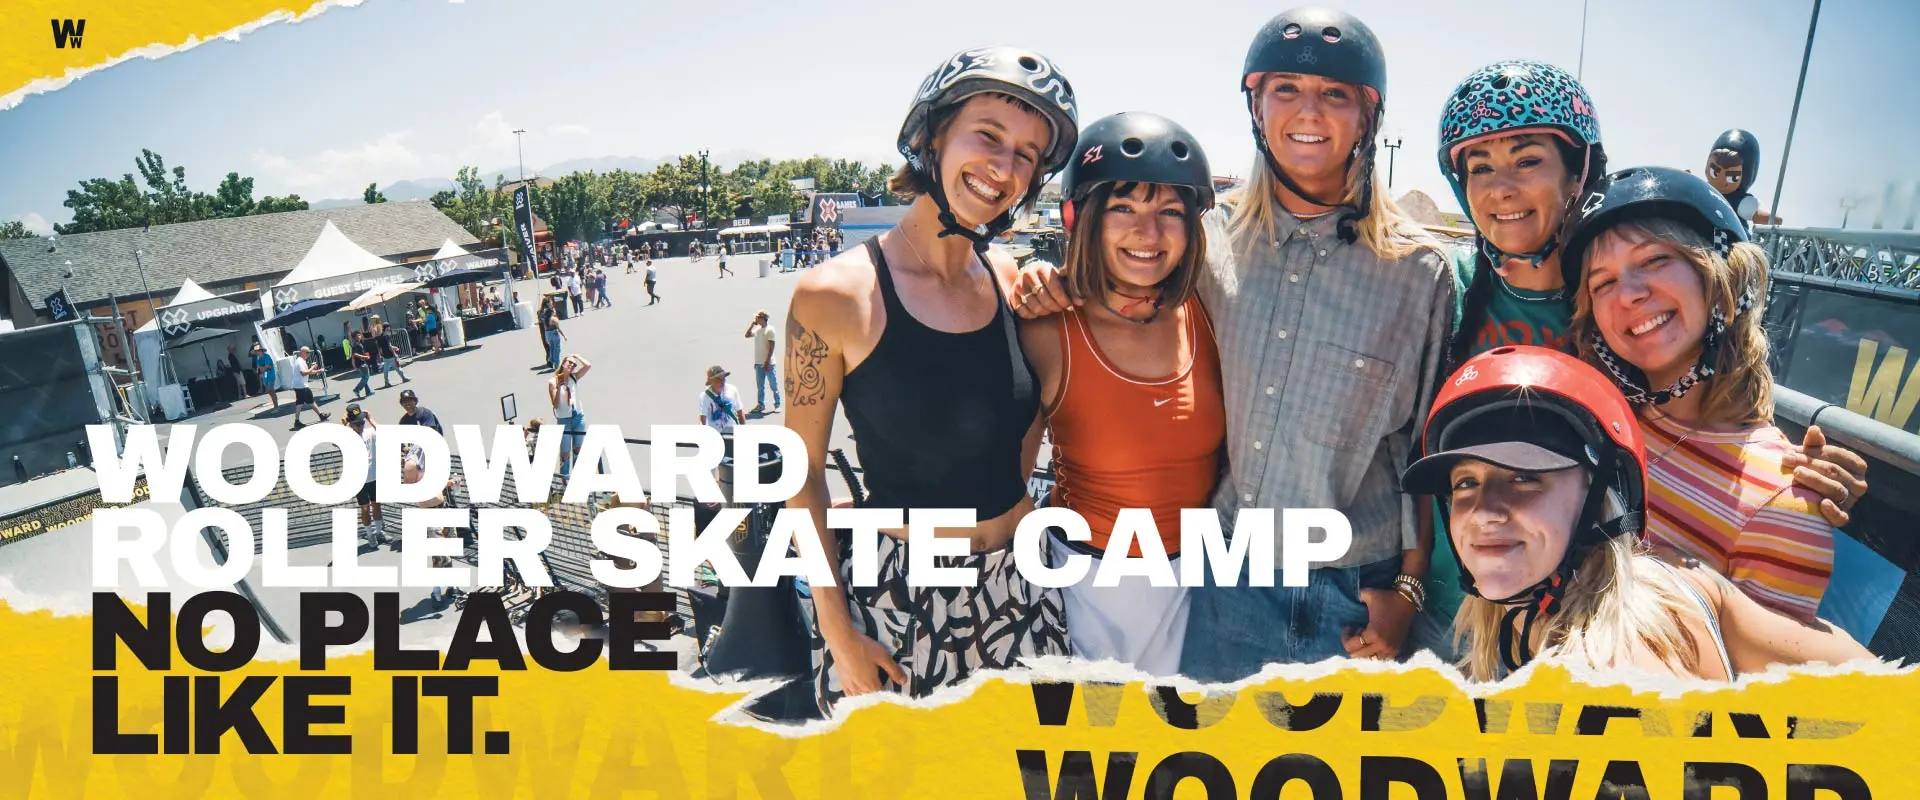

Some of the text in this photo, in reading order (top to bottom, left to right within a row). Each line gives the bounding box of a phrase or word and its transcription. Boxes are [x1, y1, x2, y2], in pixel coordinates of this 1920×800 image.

[732, 218, 751, 227] BEER
[465, 257, 500, 271] WAIVER
[314, 283, 352, 299] GUEST
[352, 273, 406, 292] SERVICES
[196, 302, 253, 321] UPGRADE
[0, 519, 42, 540] WARD
